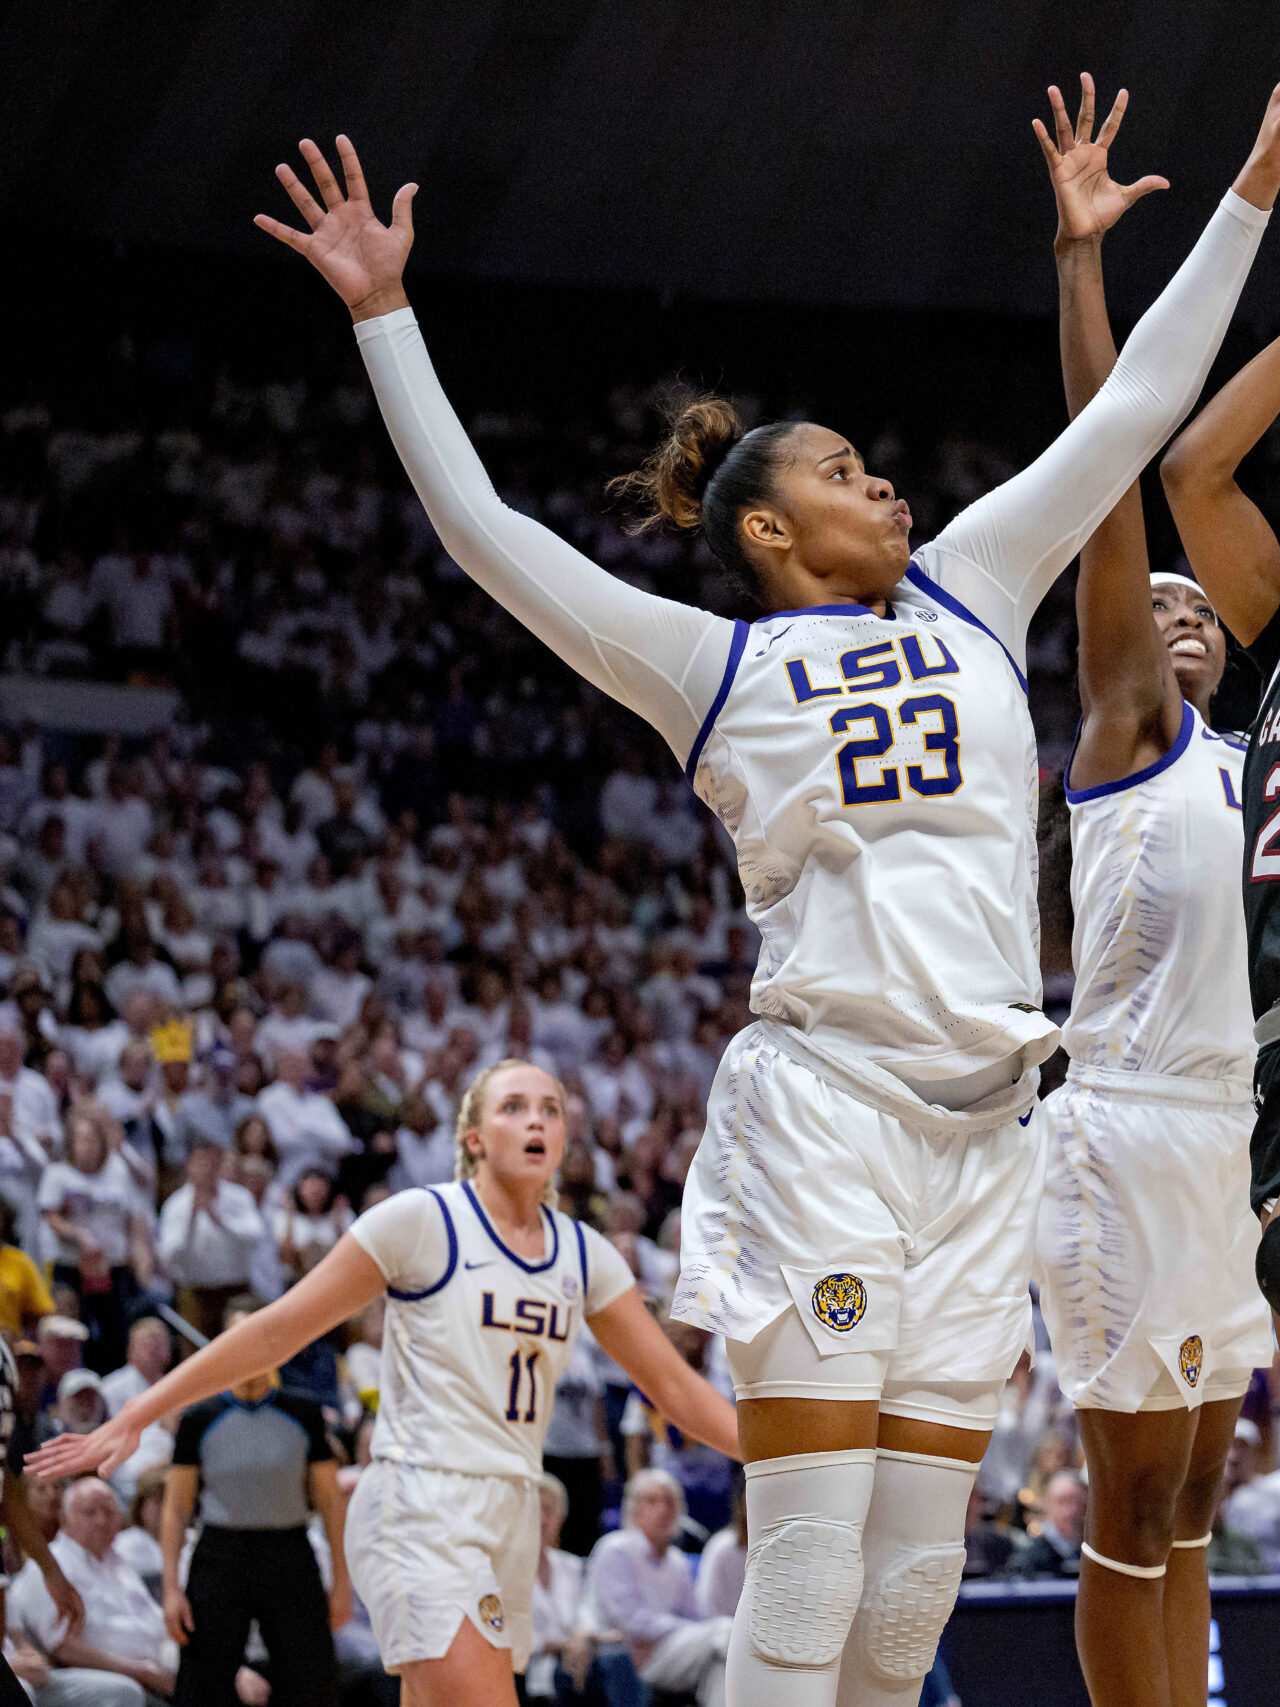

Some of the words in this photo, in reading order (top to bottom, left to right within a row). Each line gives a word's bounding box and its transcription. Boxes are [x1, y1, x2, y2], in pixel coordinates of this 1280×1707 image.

[784, 633, 961, 705] LSU
[828, 692, 965, 808] 23
[480, 1290, 573, 1343] LSU
[505, 1350, 541, 1424] 11
